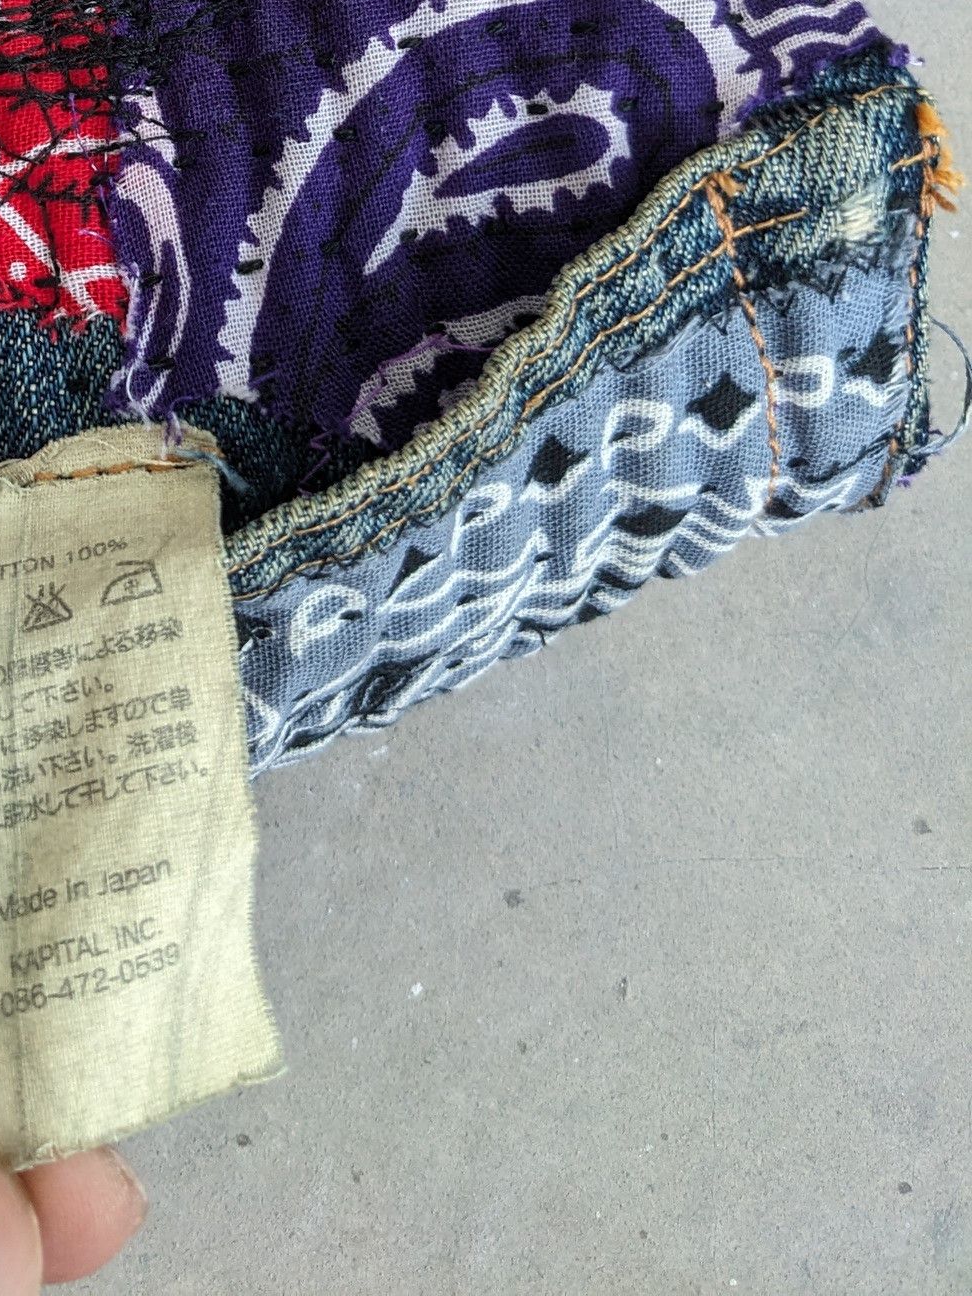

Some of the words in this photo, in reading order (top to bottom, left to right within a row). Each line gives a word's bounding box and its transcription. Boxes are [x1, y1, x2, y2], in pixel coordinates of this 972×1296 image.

[65, 536, 129, 565] 100%
[96, 858, 172, 898] Japan
[9, 934, 109, 979] KAPITAL
[114, 916, 164, 950] INC.
[0, 941, 181, 1018] 086-472-0539
